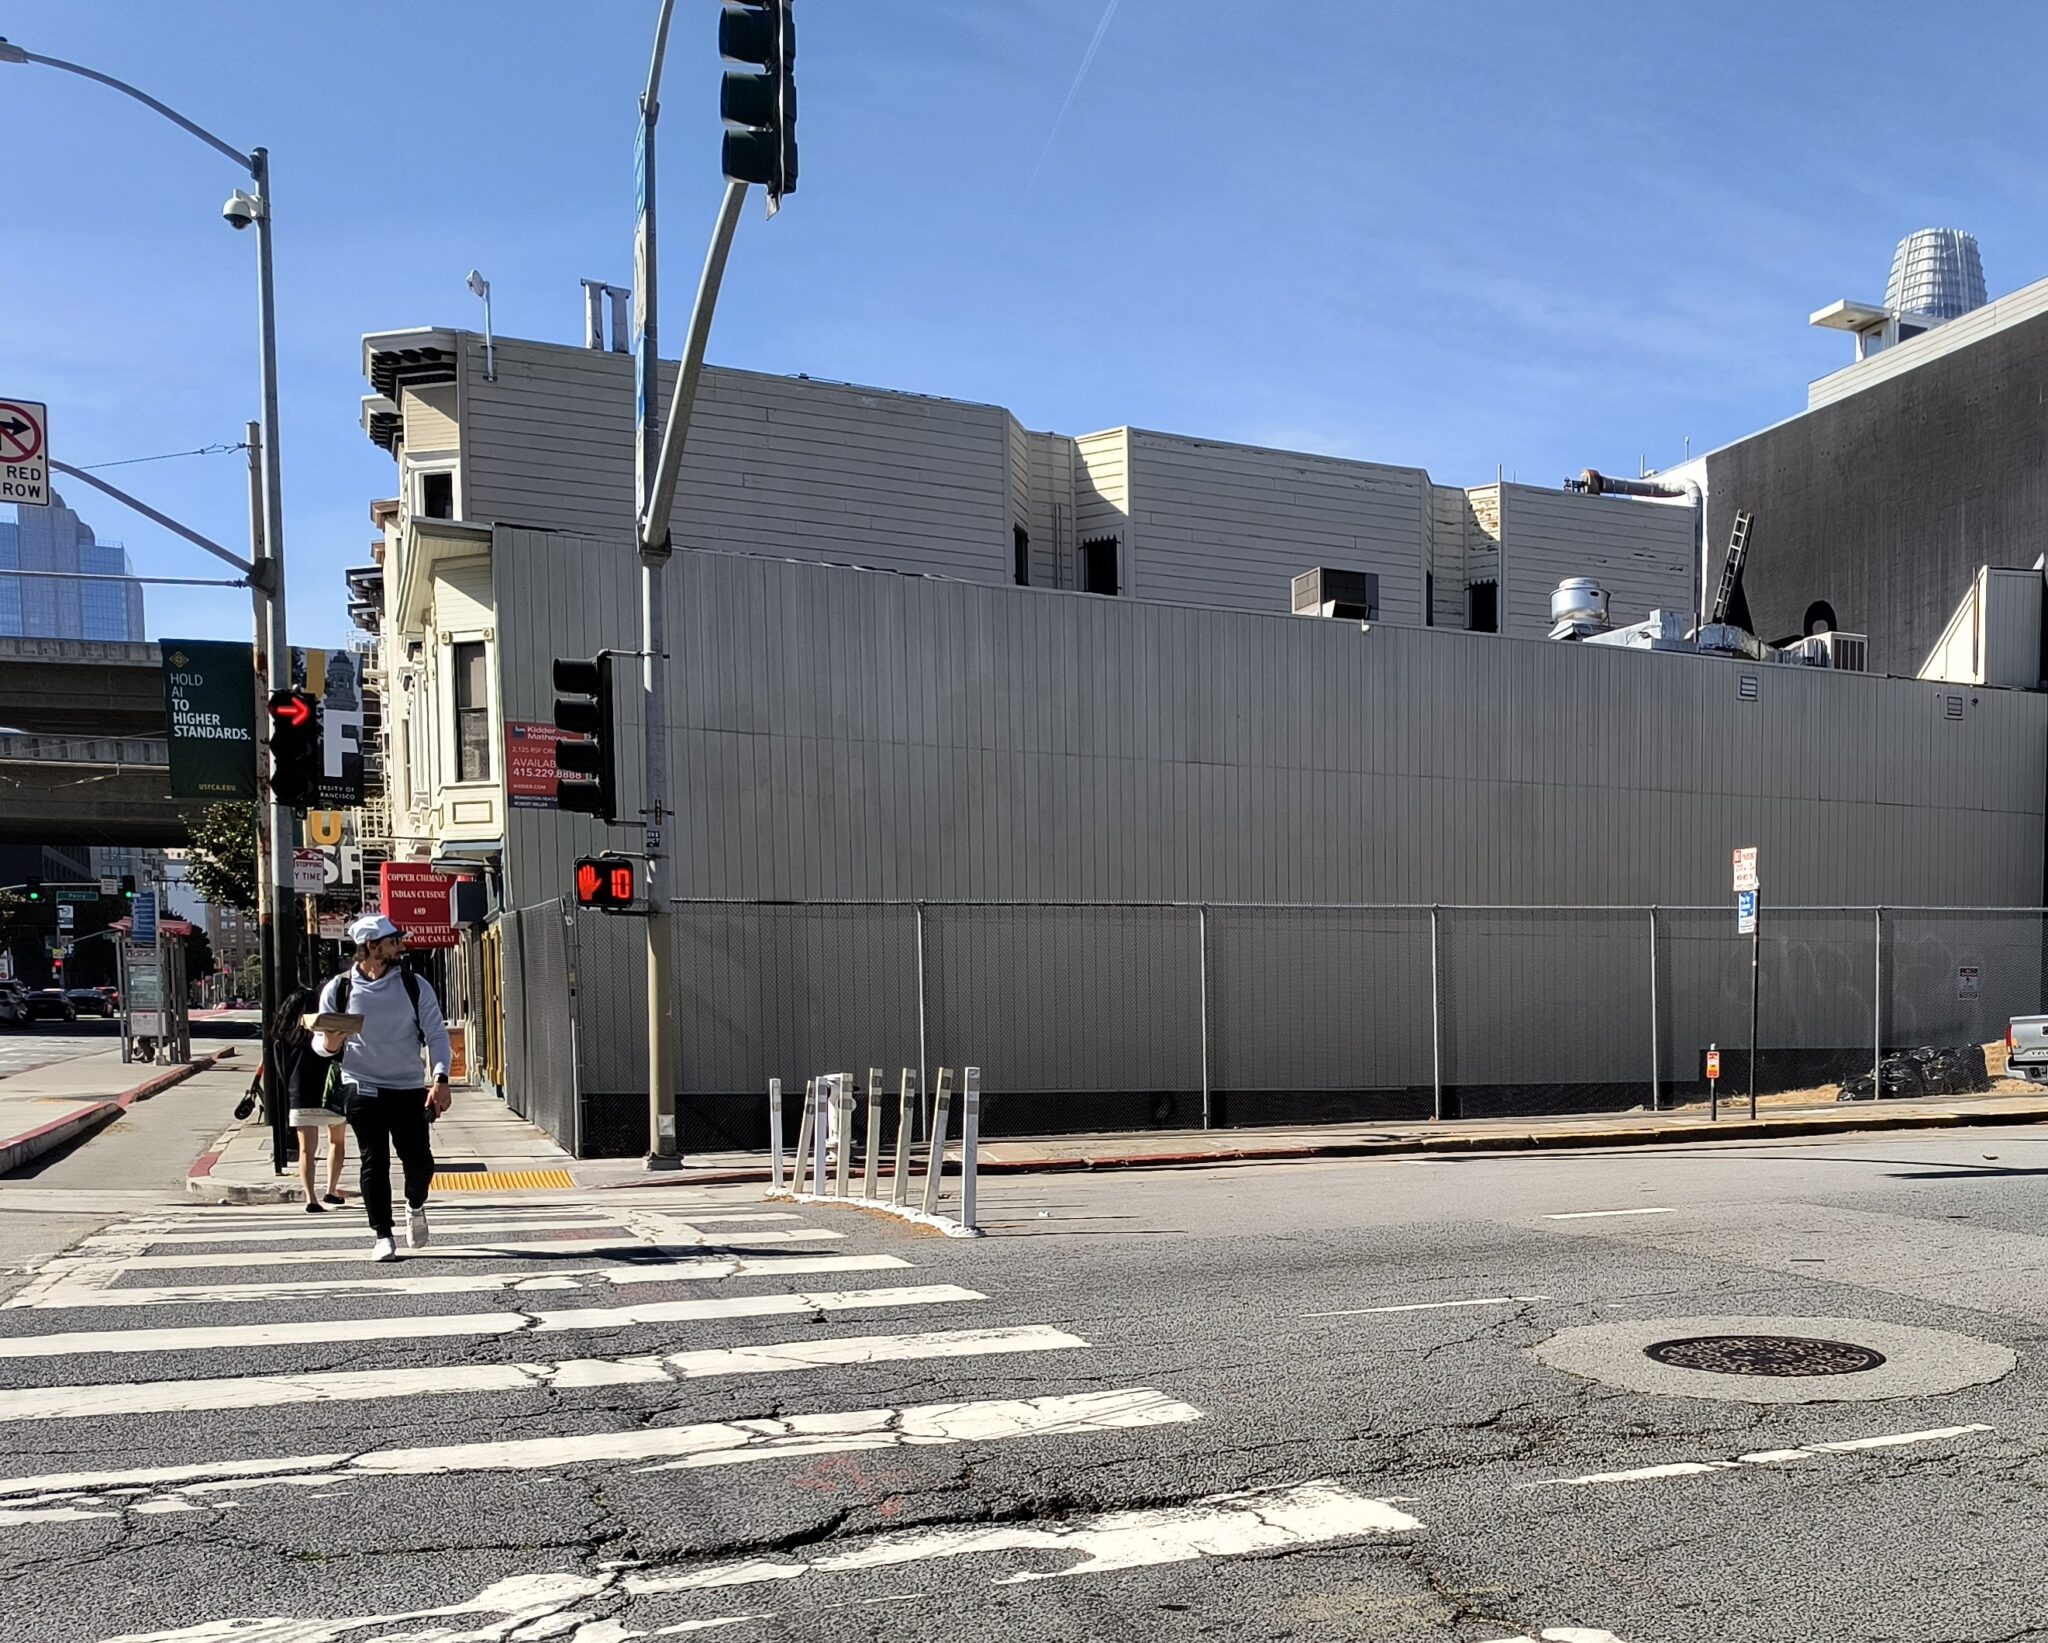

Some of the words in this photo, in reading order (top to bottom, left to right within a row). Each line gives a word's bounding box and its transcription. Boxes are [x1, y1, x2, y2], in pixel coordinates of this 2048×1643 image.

[6, 465, 42, 481] RED
[170, 672, 203, 686] HOLD
[171, 686, 184, 698] AI
[172, 699, 190, 711] TO
[173, 712, 221, 726] HIGHER
[174, 726, 252, 741] STANDARDS.
[527, 726, 557, 734] Kidder
[513, 758, 557, 768] AVAILAB
[513, 768, 582, 779] 415.229.8888
[310, 810, 342, 845] U
[303, 872, 322, 881] TIME
[387, 873, 416, 882] COPPER
[416, 873, 448, 883] CHIMNEY
[611, 869, 631, 899] 10
[391, 889, 416, 899] INDIAN
[416, 890, 447, 899] CUISINE
[413, 906, 427, 916] 489
[425, 925, 451, 935] BUFFET
[413, 935, 427, 944] YOU
[427, 935, 442, 943] CAN
[442, 935, 455, 943] EAT
